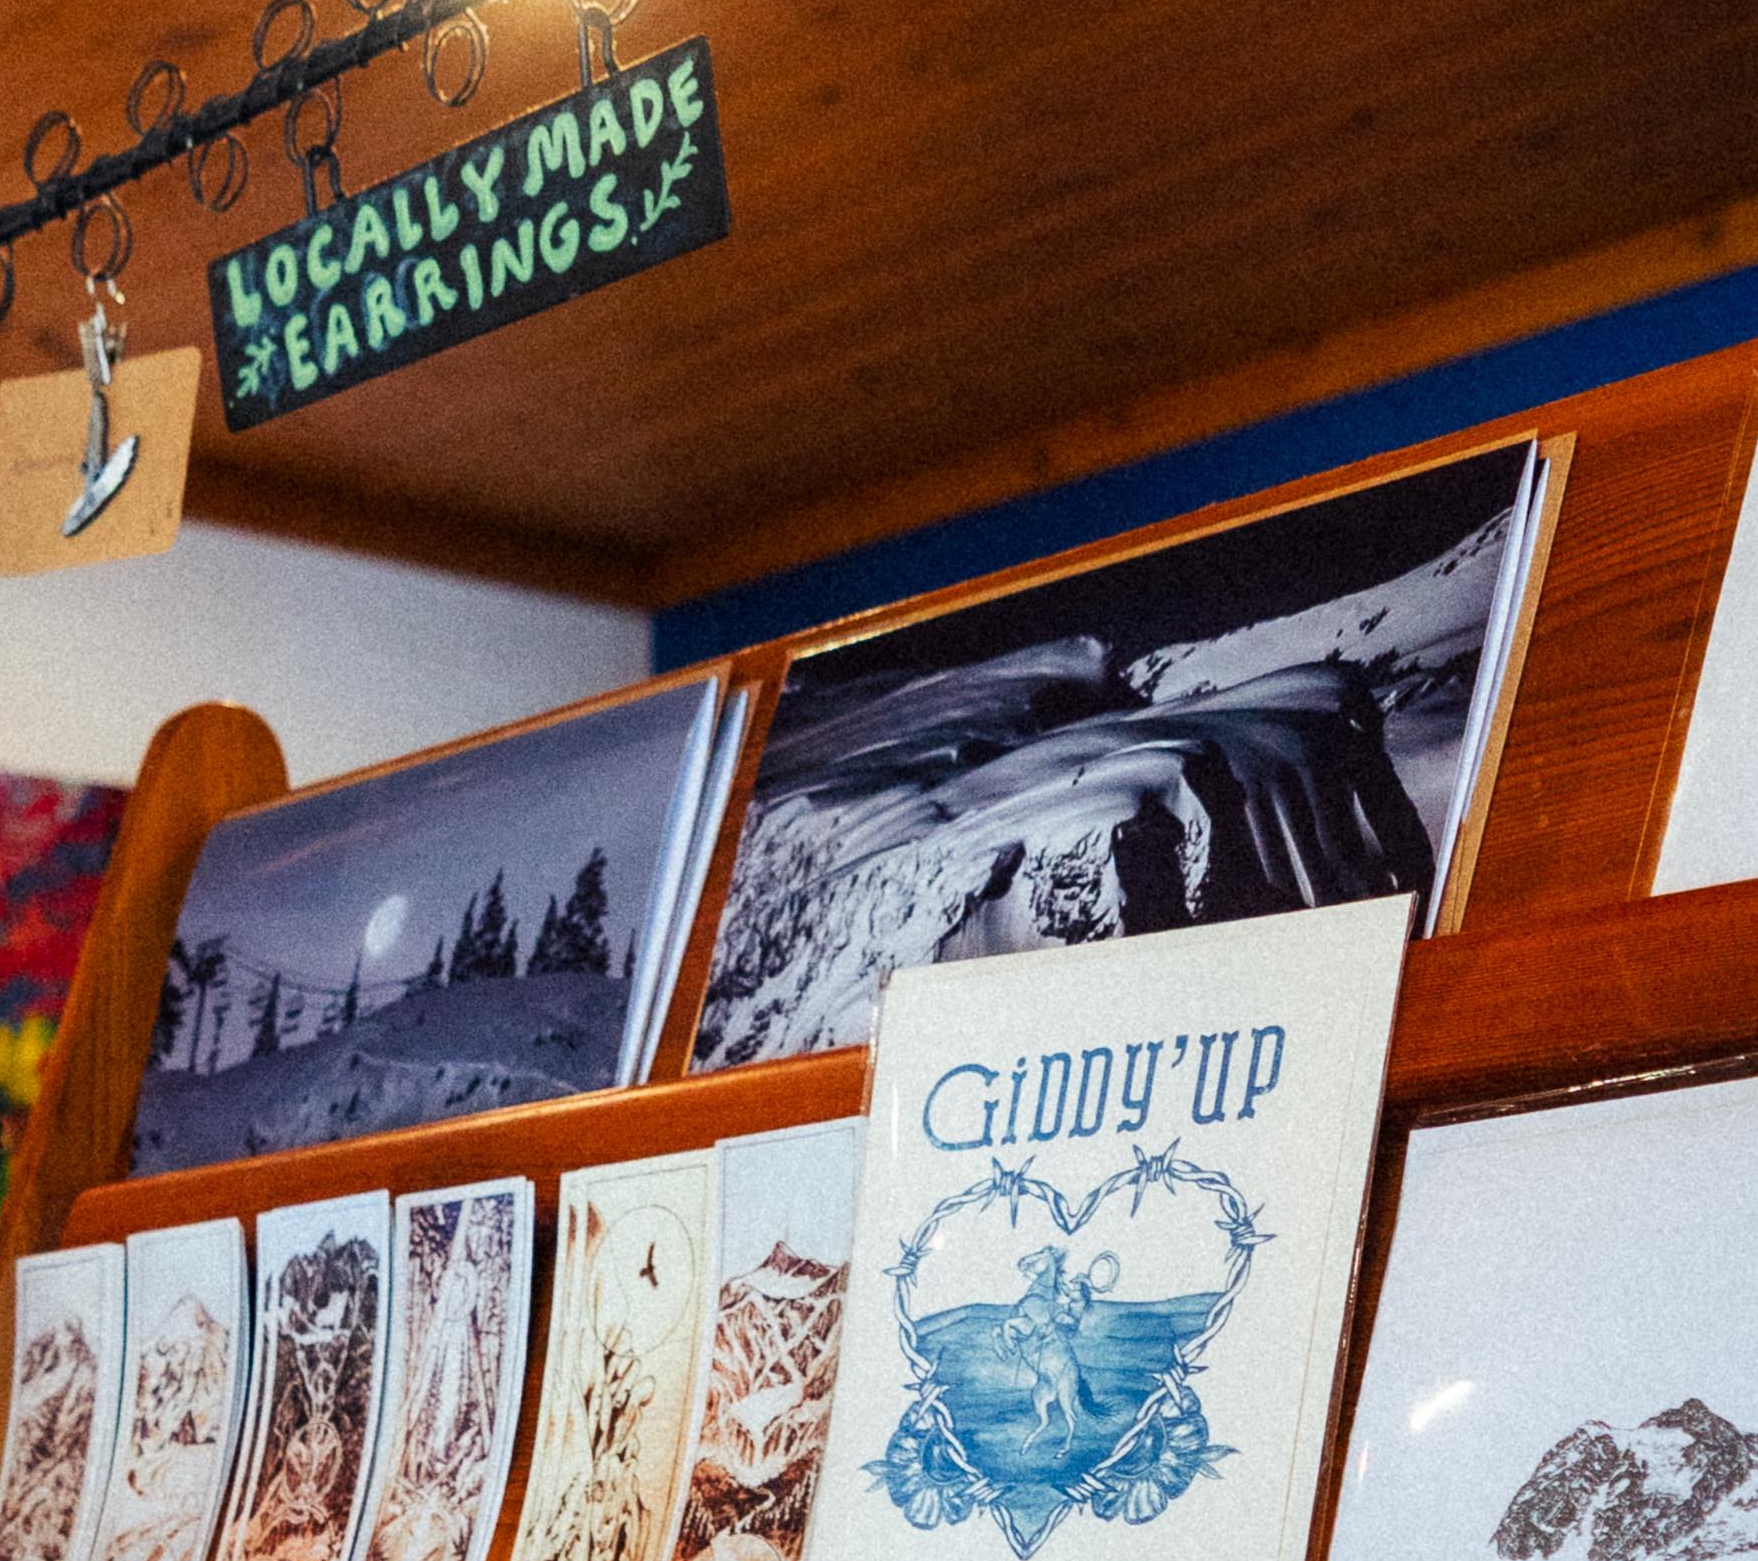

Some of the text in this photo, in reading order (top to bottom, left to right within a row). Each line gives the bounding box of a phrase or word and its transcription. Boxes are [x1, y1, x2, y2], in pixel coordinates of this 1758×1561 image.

[227, 57, 703, 328] LOCALLY MADE
[284, 173, 630, 390] EARRINGS
